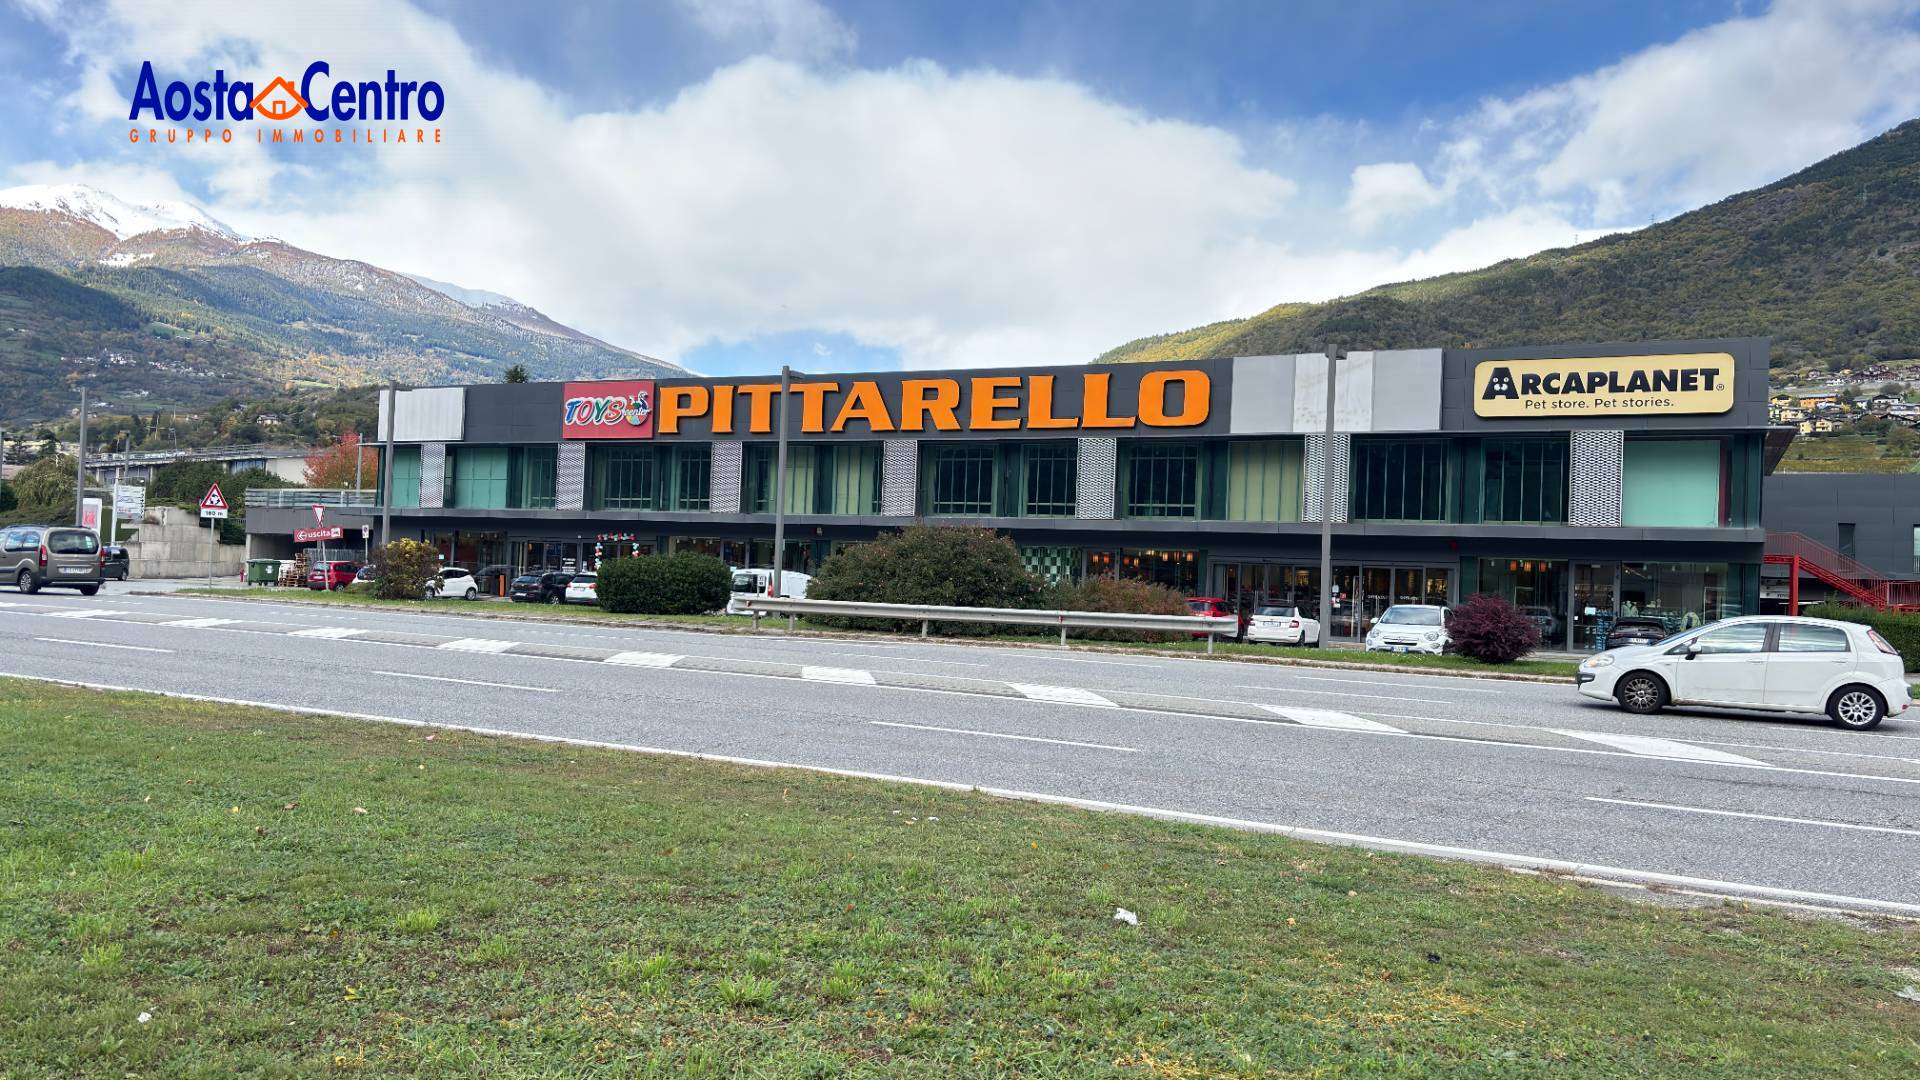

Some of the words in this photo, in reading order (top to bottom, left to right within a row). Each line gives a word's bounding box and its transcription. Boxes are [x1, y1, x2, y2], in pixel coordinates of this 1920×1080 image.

[1482, 367, 1720, 400] ARCAPLANET
[565, 396, 627, 425] TOYS
[657, 369, 1211, 434] PITTARELLO
[1525, 399, 1547, 410] Pet
[1551, 398, 1590, 410] store.
[1594, 398, 1617, 409] Pet
[1621, 396, 1675, 408] stories.
[307, 529, 332, 539] uscita
